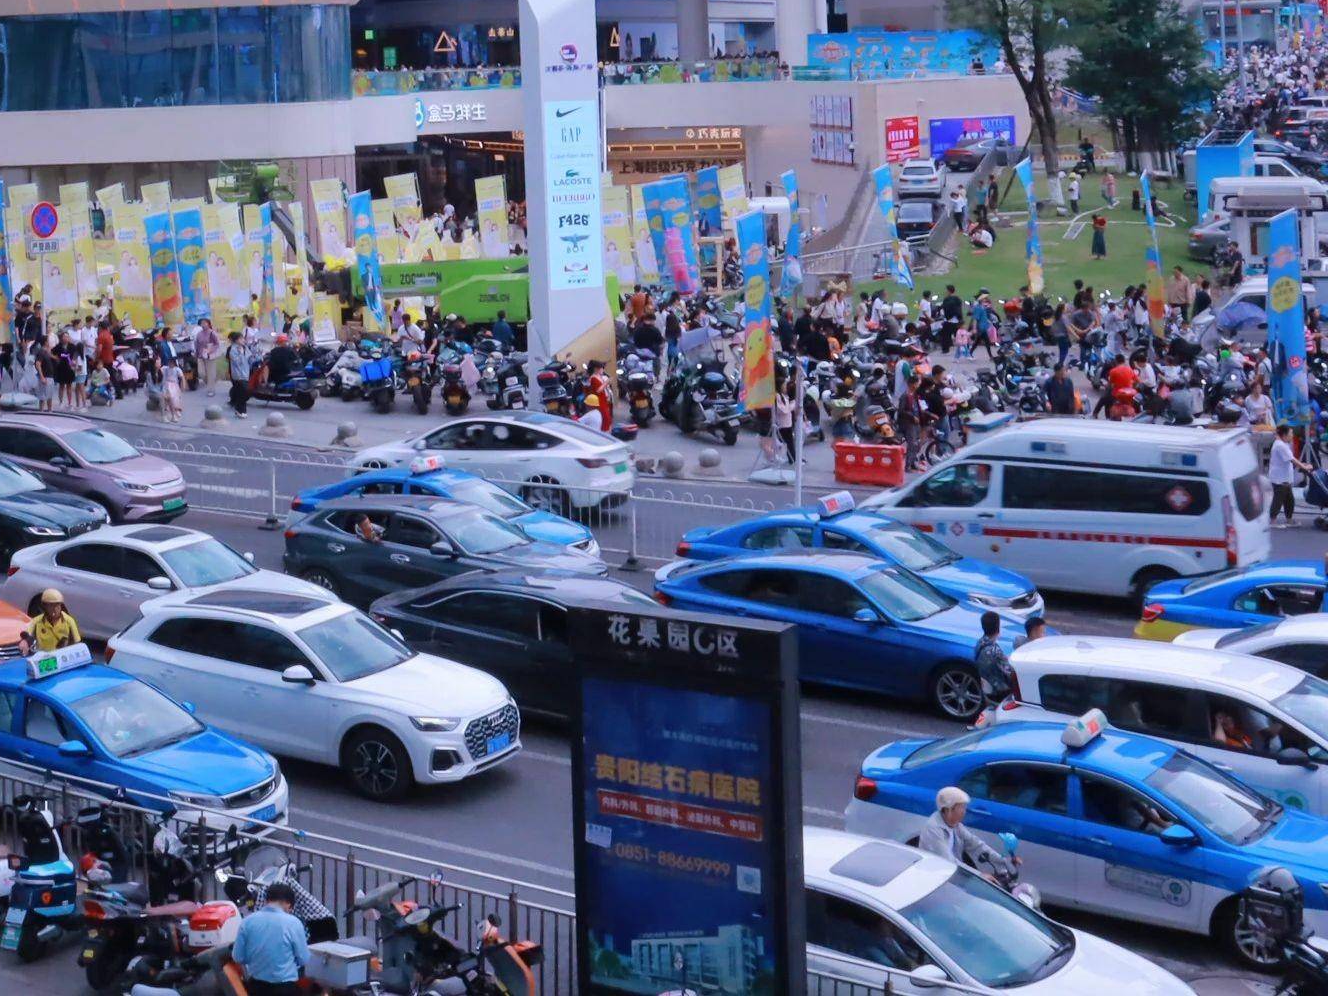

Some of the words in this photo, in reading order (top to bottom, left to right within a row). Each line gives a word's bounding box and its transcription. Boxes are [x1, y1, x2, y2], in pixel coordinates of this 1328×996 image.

[427, 102, 487, 123] 盒马鲜生
[561, 126, 581, 143] GAP
[553, 177, 592, 186] LACOSTE
[559, 214, 589, 229] F426
[607, 614, 739, 658] 花果园C区
[594, 753, 761, 806] 贵阳结石病医院
